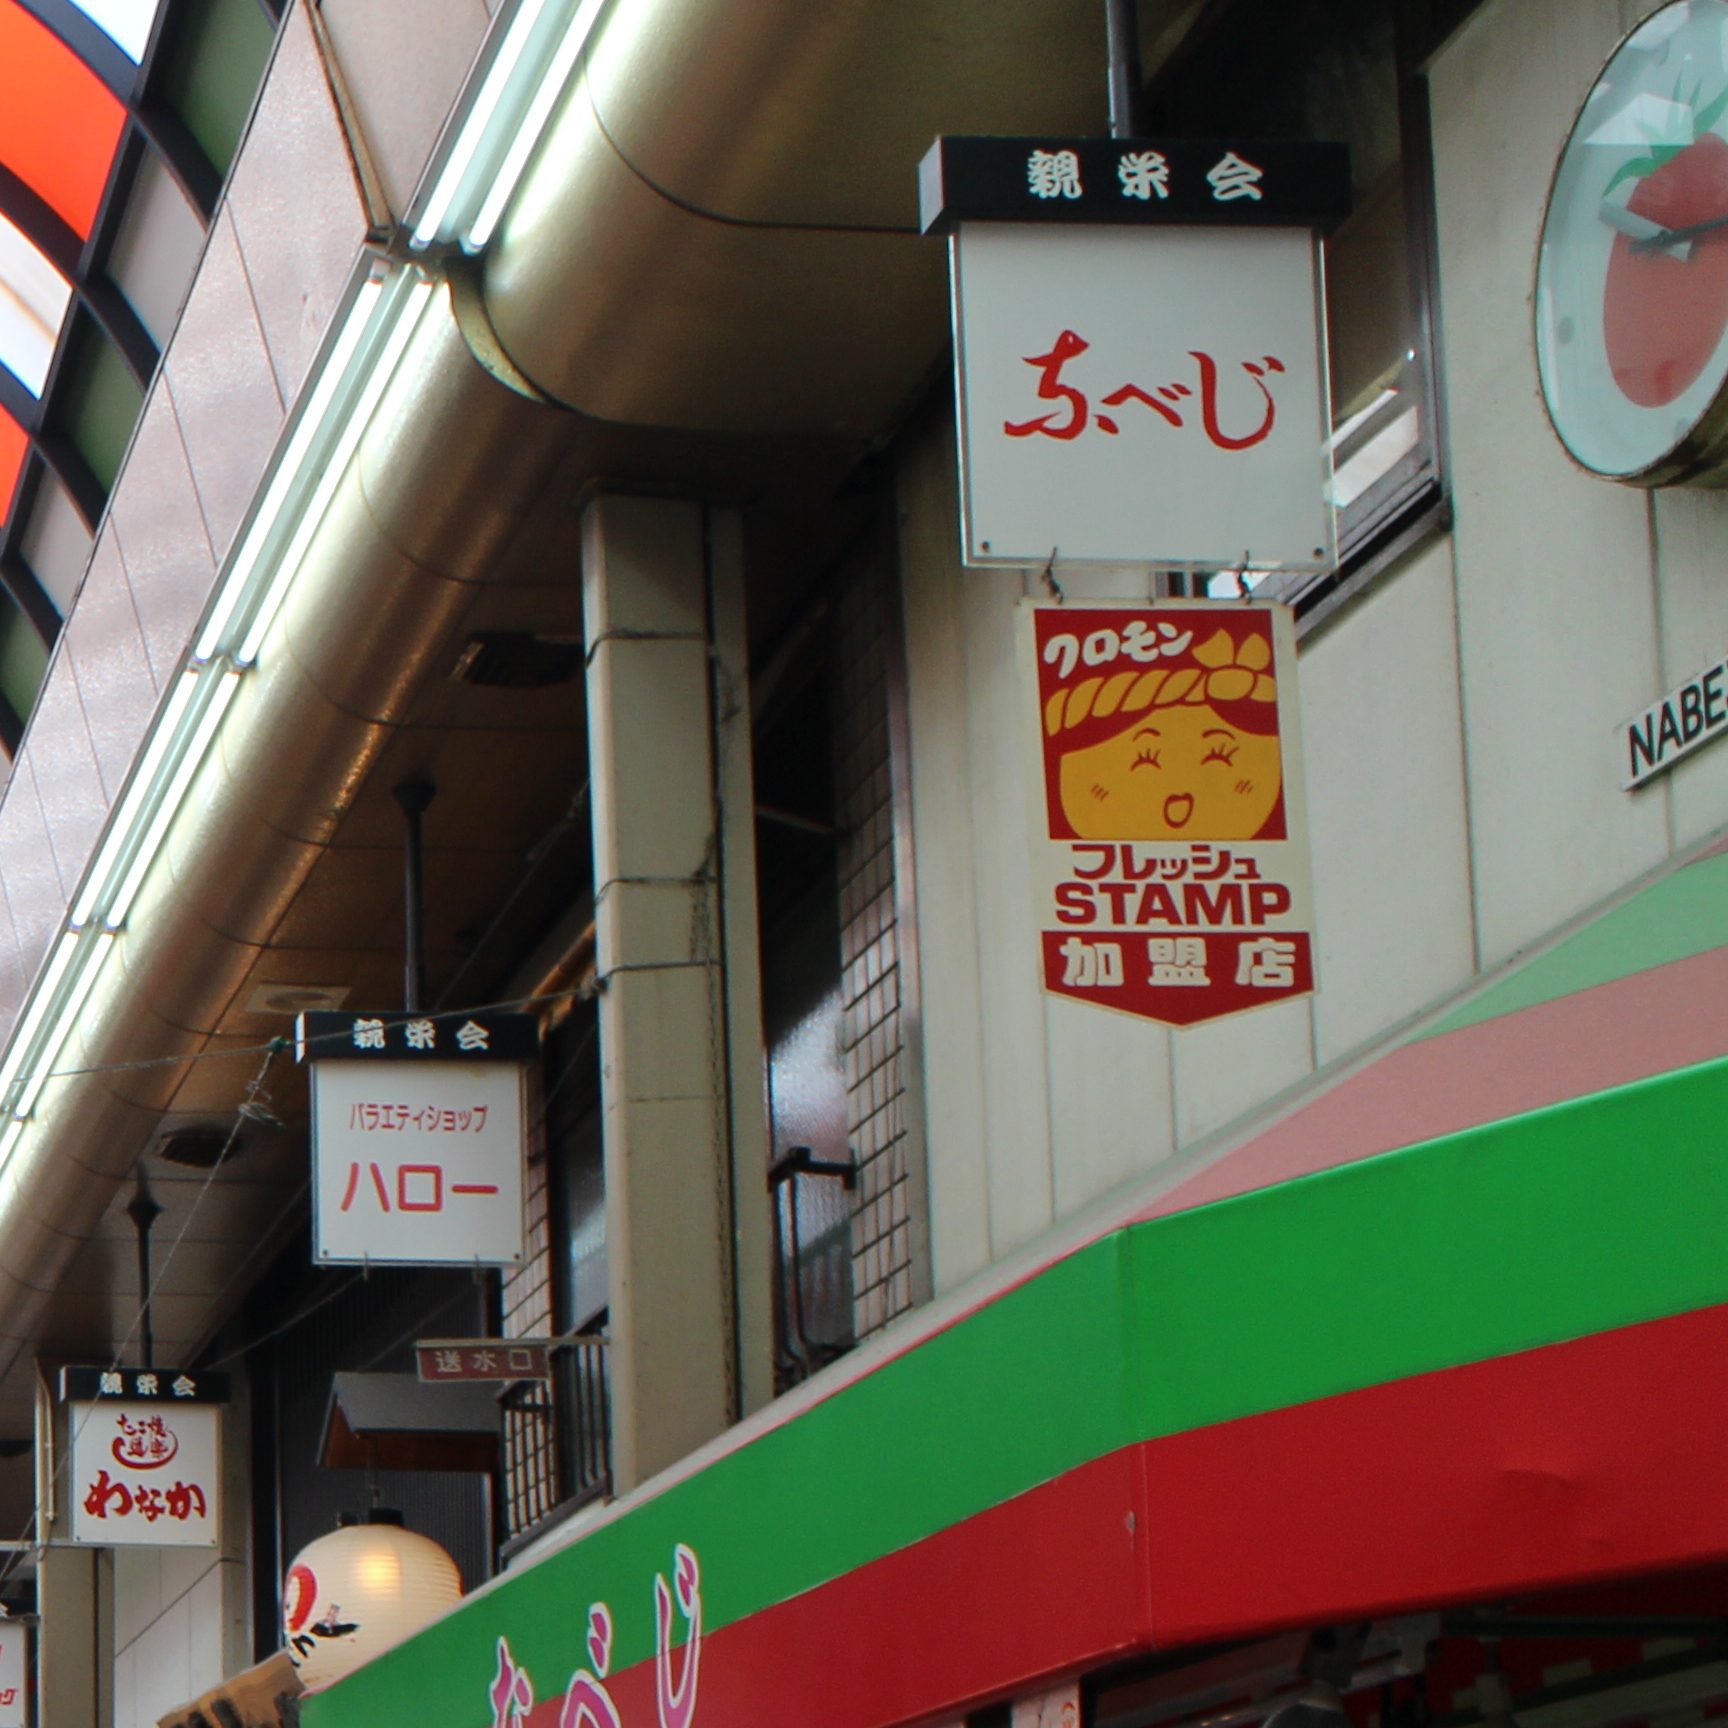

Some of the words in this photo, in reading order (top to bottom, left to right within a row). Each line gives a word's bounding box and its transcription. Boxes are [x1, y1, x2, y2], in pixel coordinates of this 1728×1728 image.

[1026, 149, 1265, 201] 親栄会
[1043, 618, 1195, 680] クロモン
[1628, 658, 1728, 778] NABE
[1071, 844, 1261, 881] フレッシュ
[1054, 882, 1292, 927] STAMP
[1060, 936, 1296, 989] 加盟店
[352, 1018, 490, 1052] 親栄会
[348, 1102, 489, 1134] バラエティショップ
[341, 1160, 499, 1213] ハロー
[99, 1370, 197, 1396] 親栄会
[435, 1348, 534, 1374] 送水口
[83, 1470, 206, 1524] わなか
